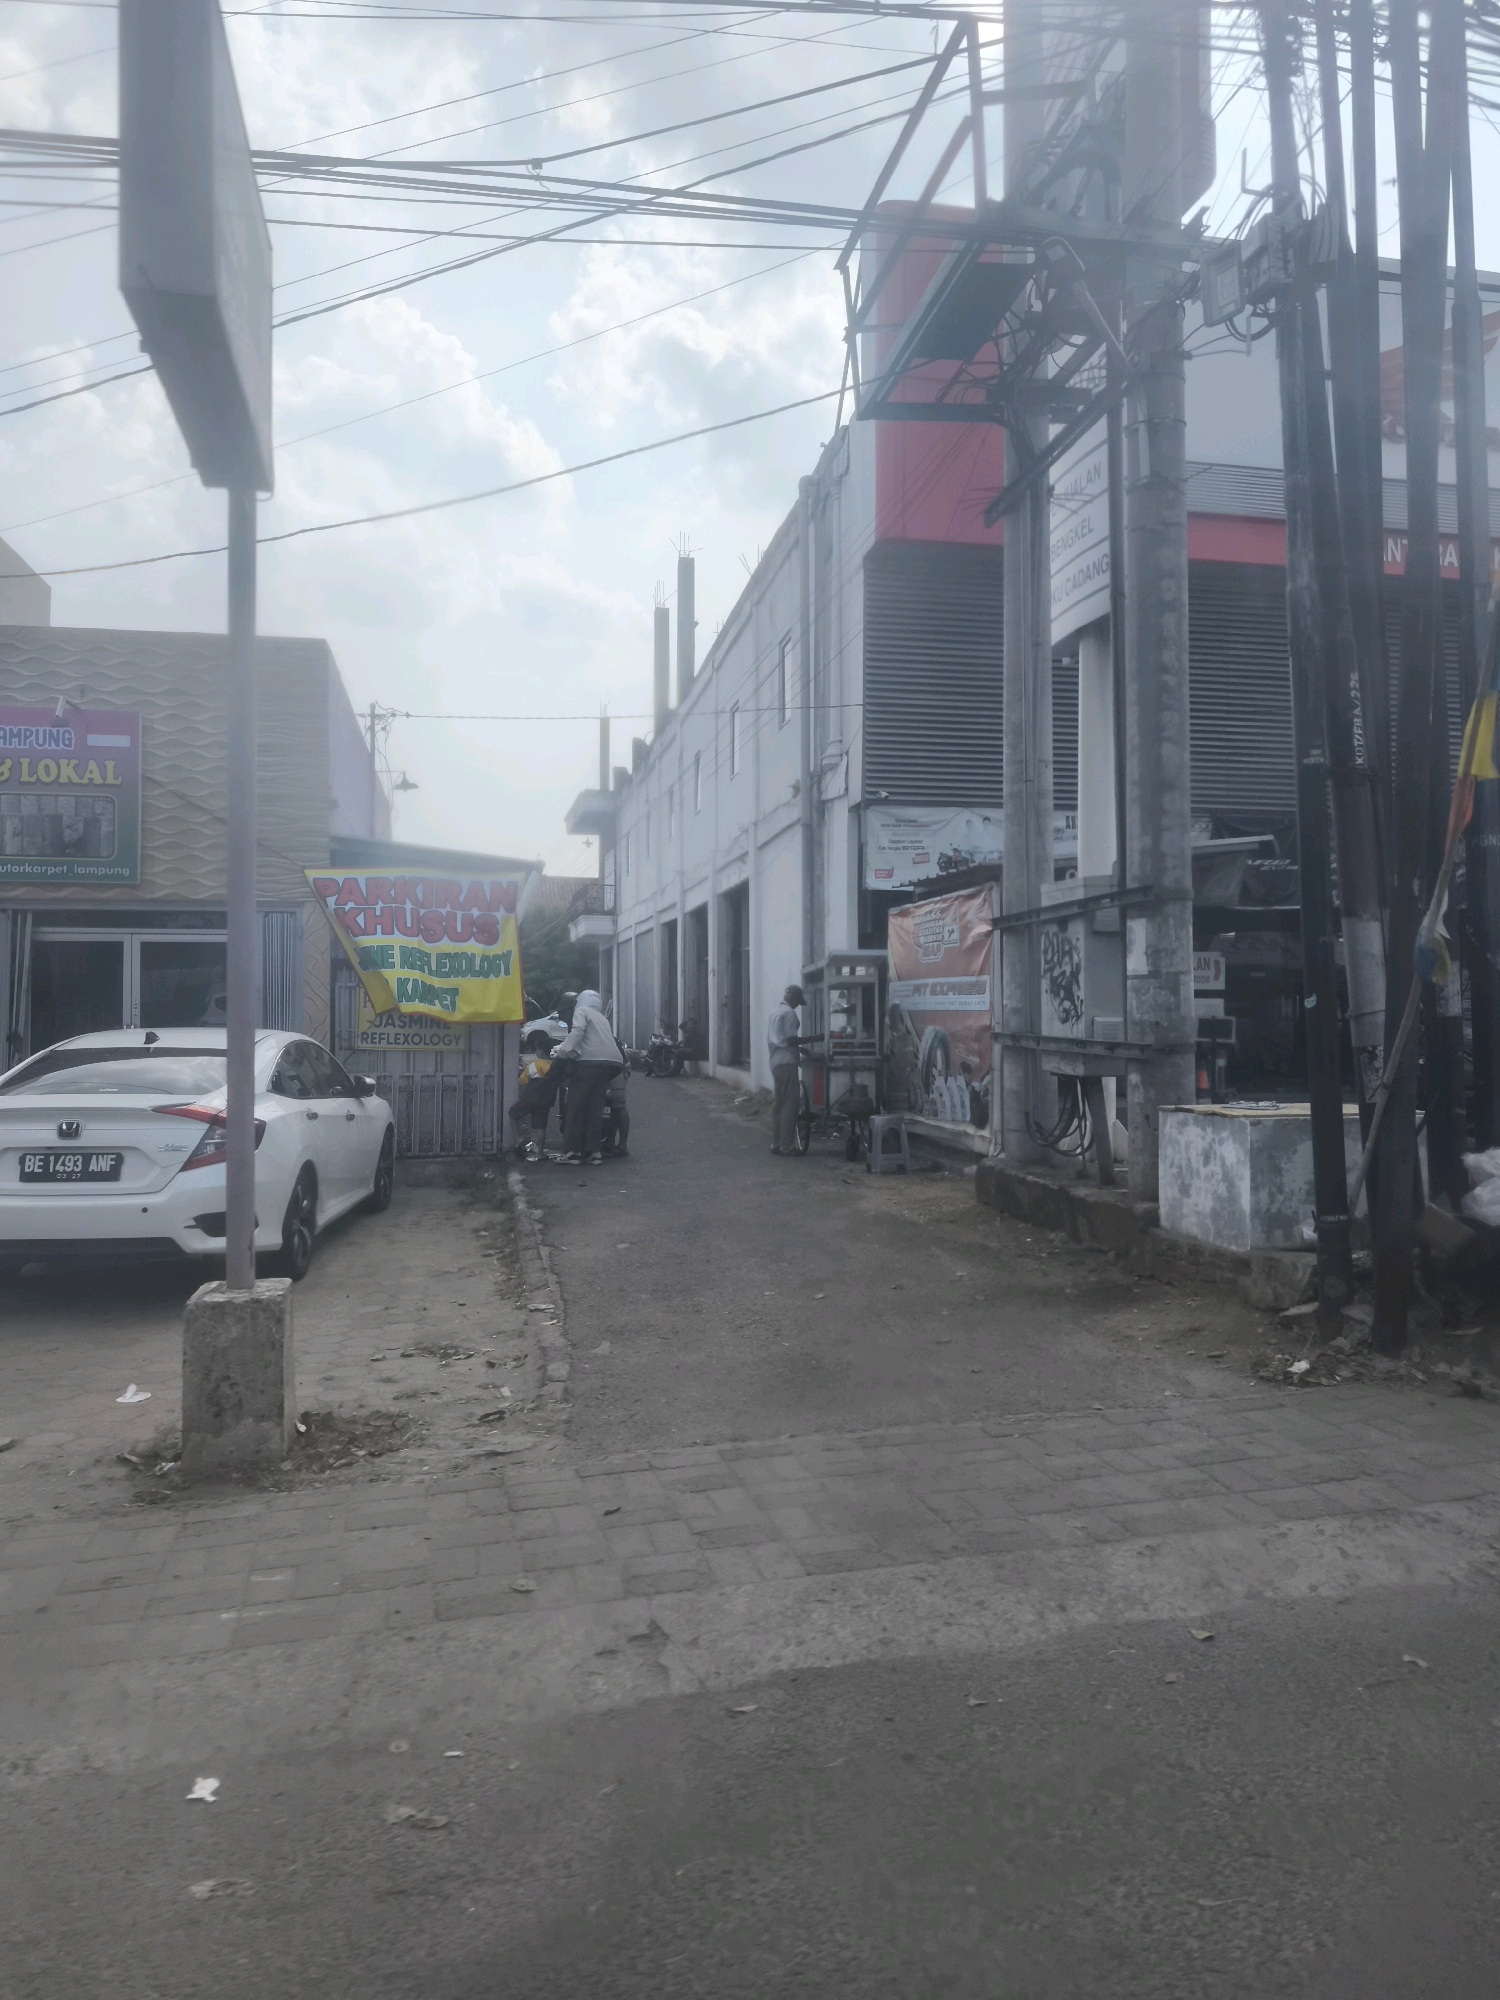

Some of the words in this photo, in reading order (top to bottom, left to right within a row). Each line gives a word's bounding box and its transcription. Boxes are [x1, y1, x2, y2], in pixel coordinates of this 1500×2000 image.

[1051, 516, 1094, 562] BENGKEL
[1065, 553, 1110, 596] CADANG
[19, 757, 122, 785] LOKAL
[312, 876, 518, 913] PARKIRAN
[333, 906, 500, 946] KHUSUS
[399, 944, 513, 979] REFLEXOLOGY
[397, 977, 459, 1013] KARPET
[360, 1032, 462, 1046] REFLEXOLOGY
[24, 1155, 45, 1173] BE
[49, 1155, 82, 1173] 1493
[89, 1154, 117, 1172] ANF
